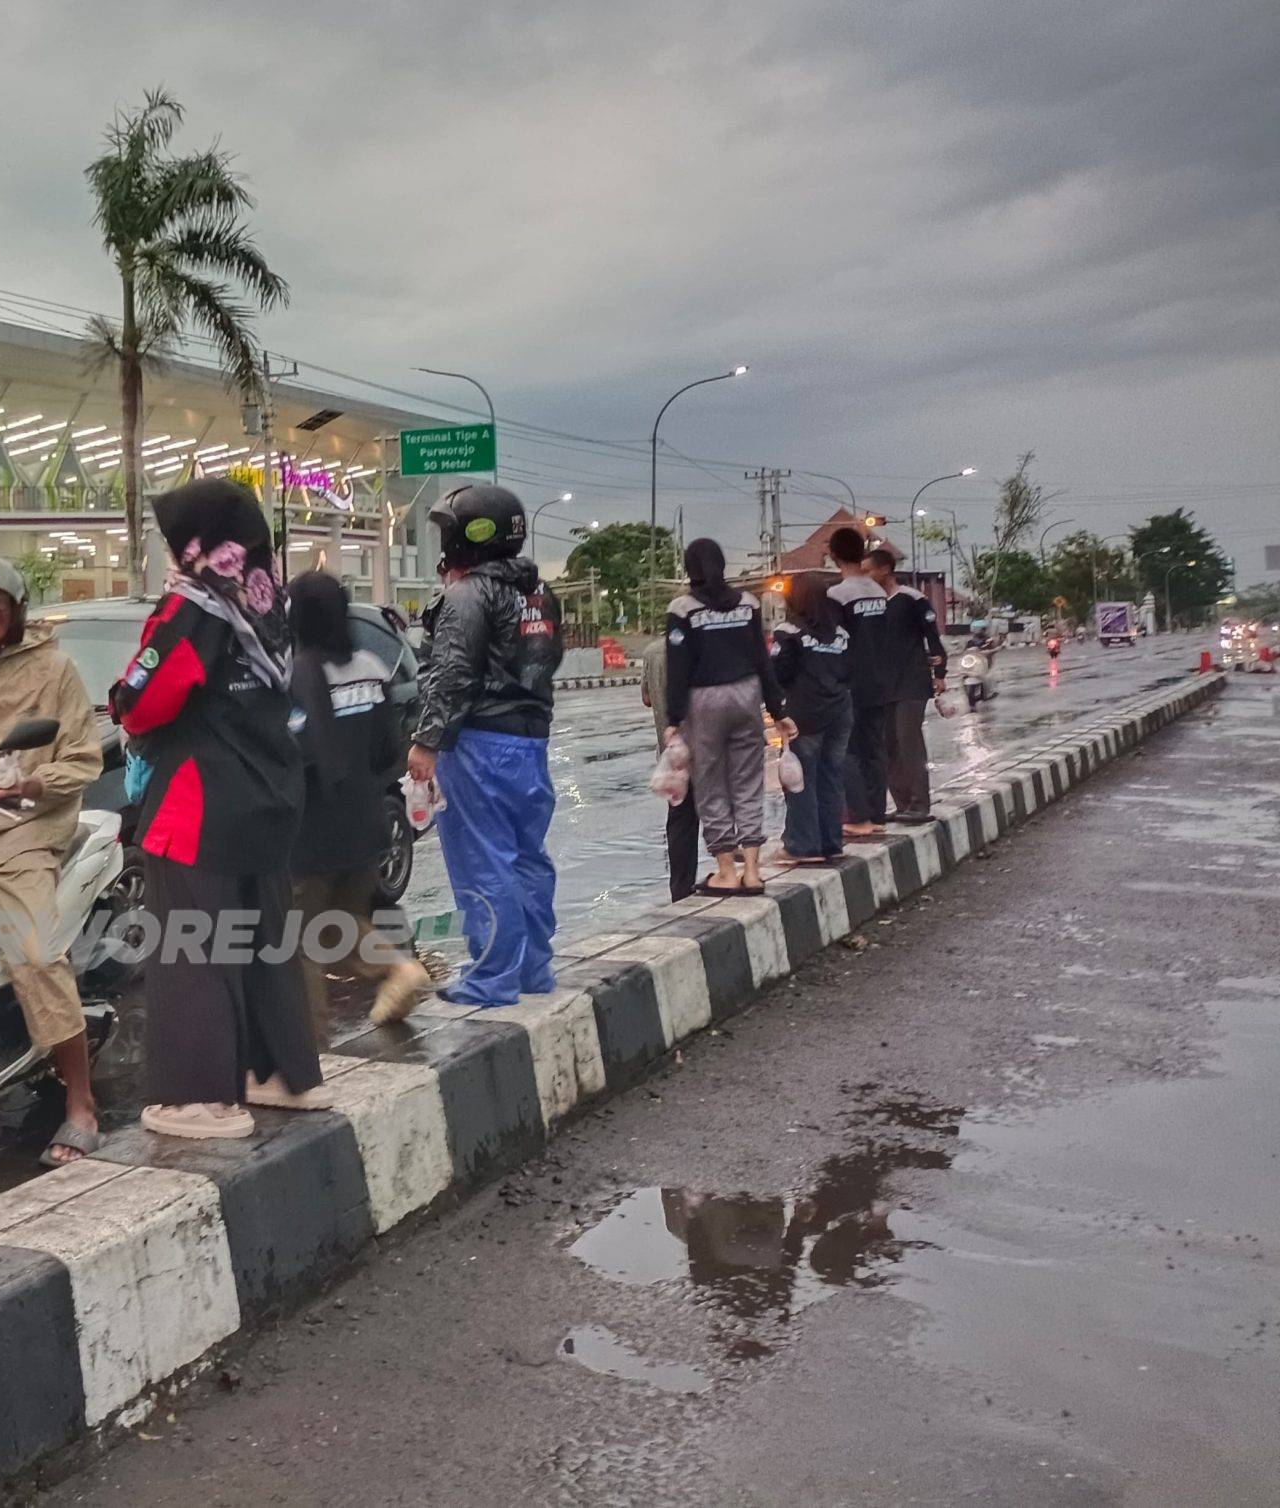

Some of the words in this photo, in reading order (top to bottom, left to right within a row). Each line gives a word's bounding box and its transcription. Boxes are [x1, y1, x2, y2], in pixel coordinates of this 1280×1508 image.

[405, 432, 451, 444] Terminal
[455, 430, 478, 442] Tipe
[481, 429, 490, 439] A
[420, 444, 475, 457] Purworejo
[441, 459, 472, 470] Meter
